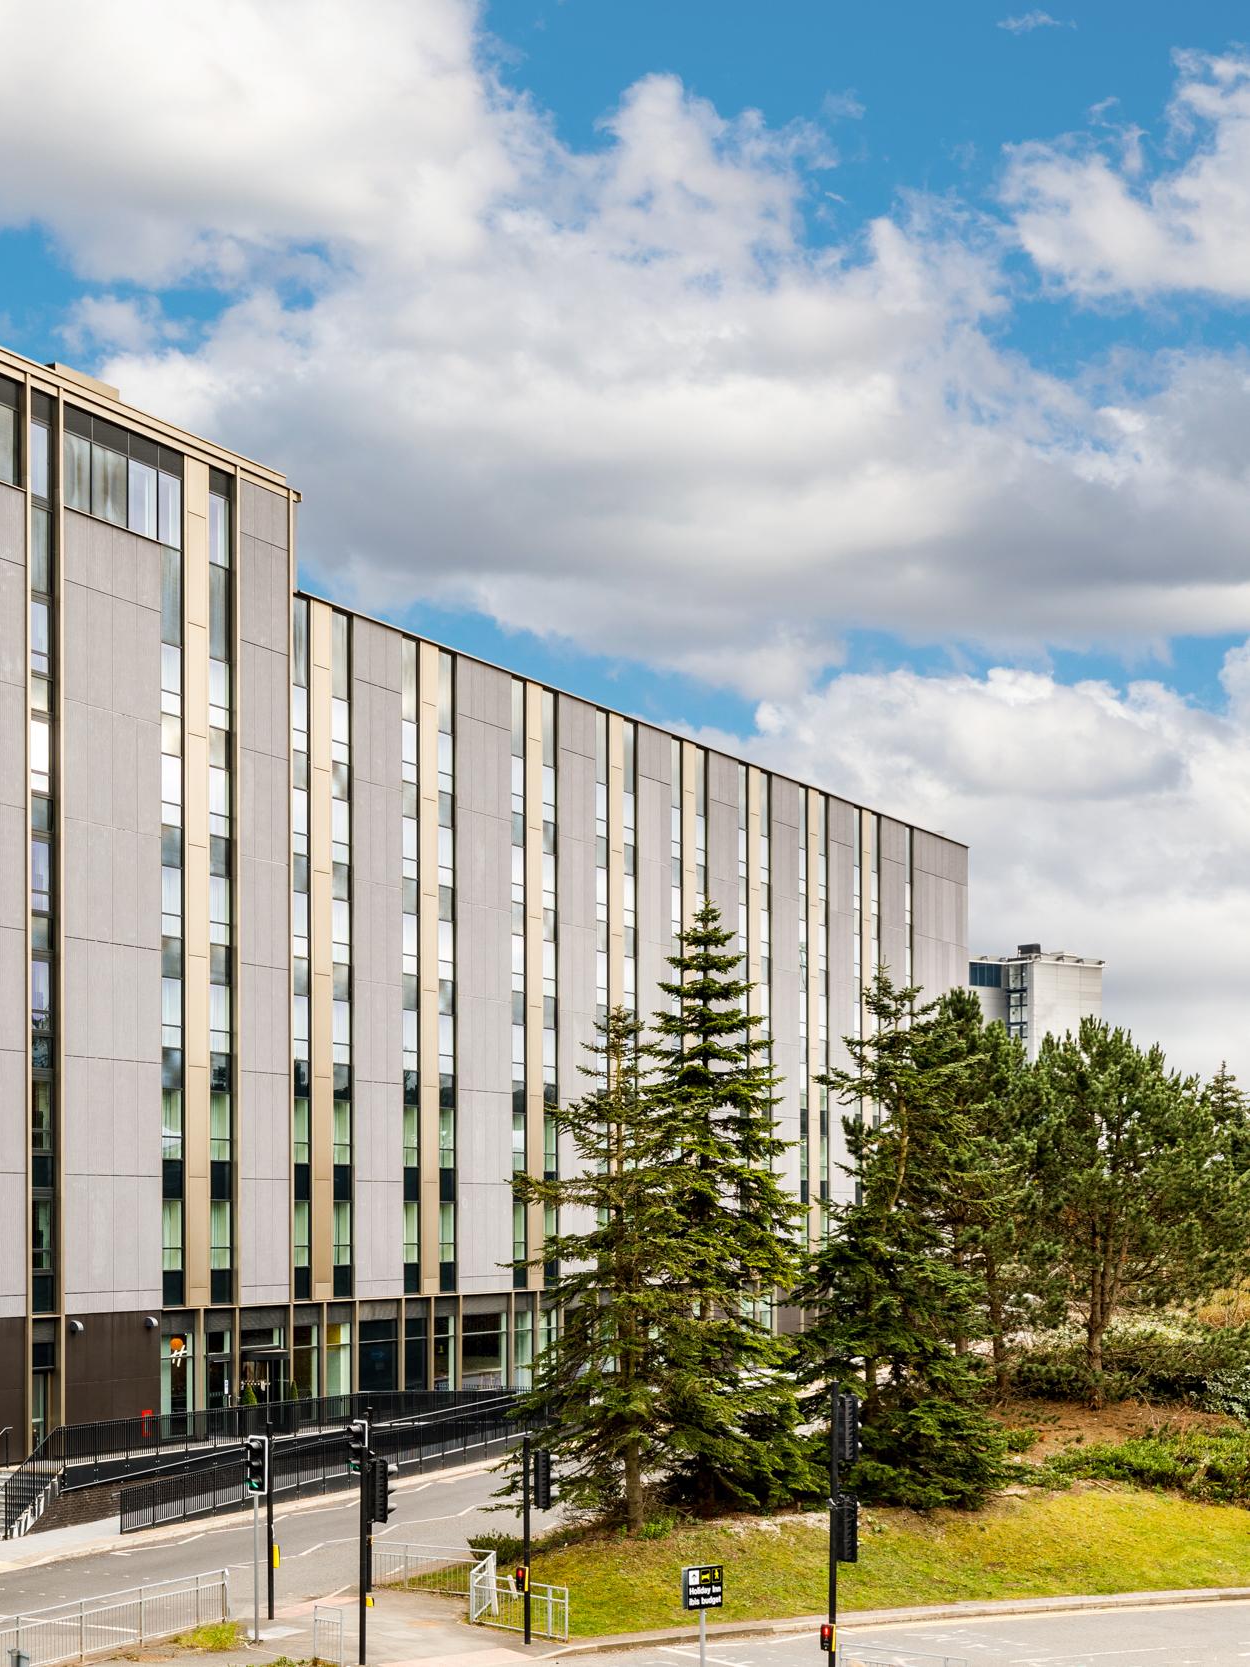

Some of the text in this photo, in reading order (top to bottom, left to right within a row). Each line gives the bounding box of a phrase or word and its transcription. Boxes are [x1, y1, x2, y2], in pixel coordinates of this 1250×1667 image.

[688, 1585, 721, 1595] Holiday Inn
[701, 1595, 722, 1605] budget
